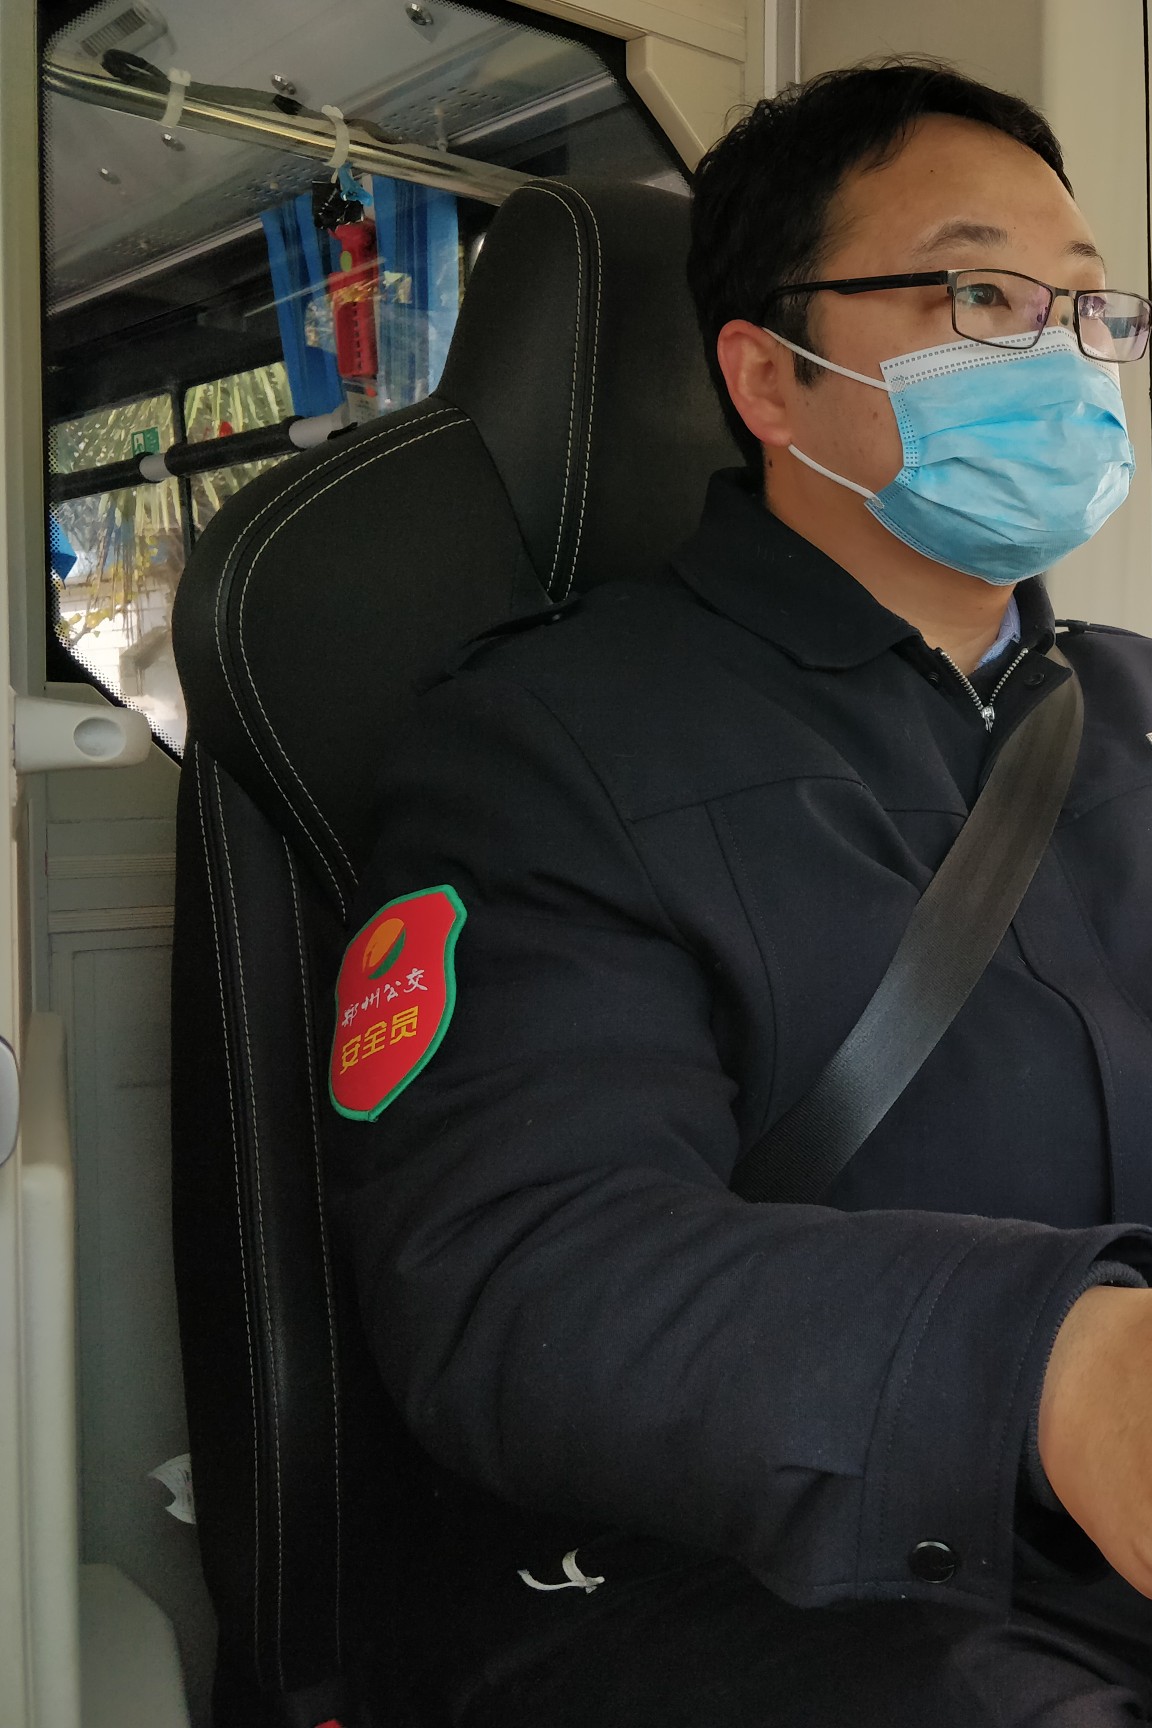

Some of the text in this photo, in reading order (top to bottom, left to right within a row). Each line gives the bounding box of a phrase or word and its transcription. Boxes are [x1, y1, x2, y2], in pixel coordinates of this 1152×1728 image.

[341, 967, 428, 1028] 郑州公交
[339, 1005, 419, 1075] 安全员
